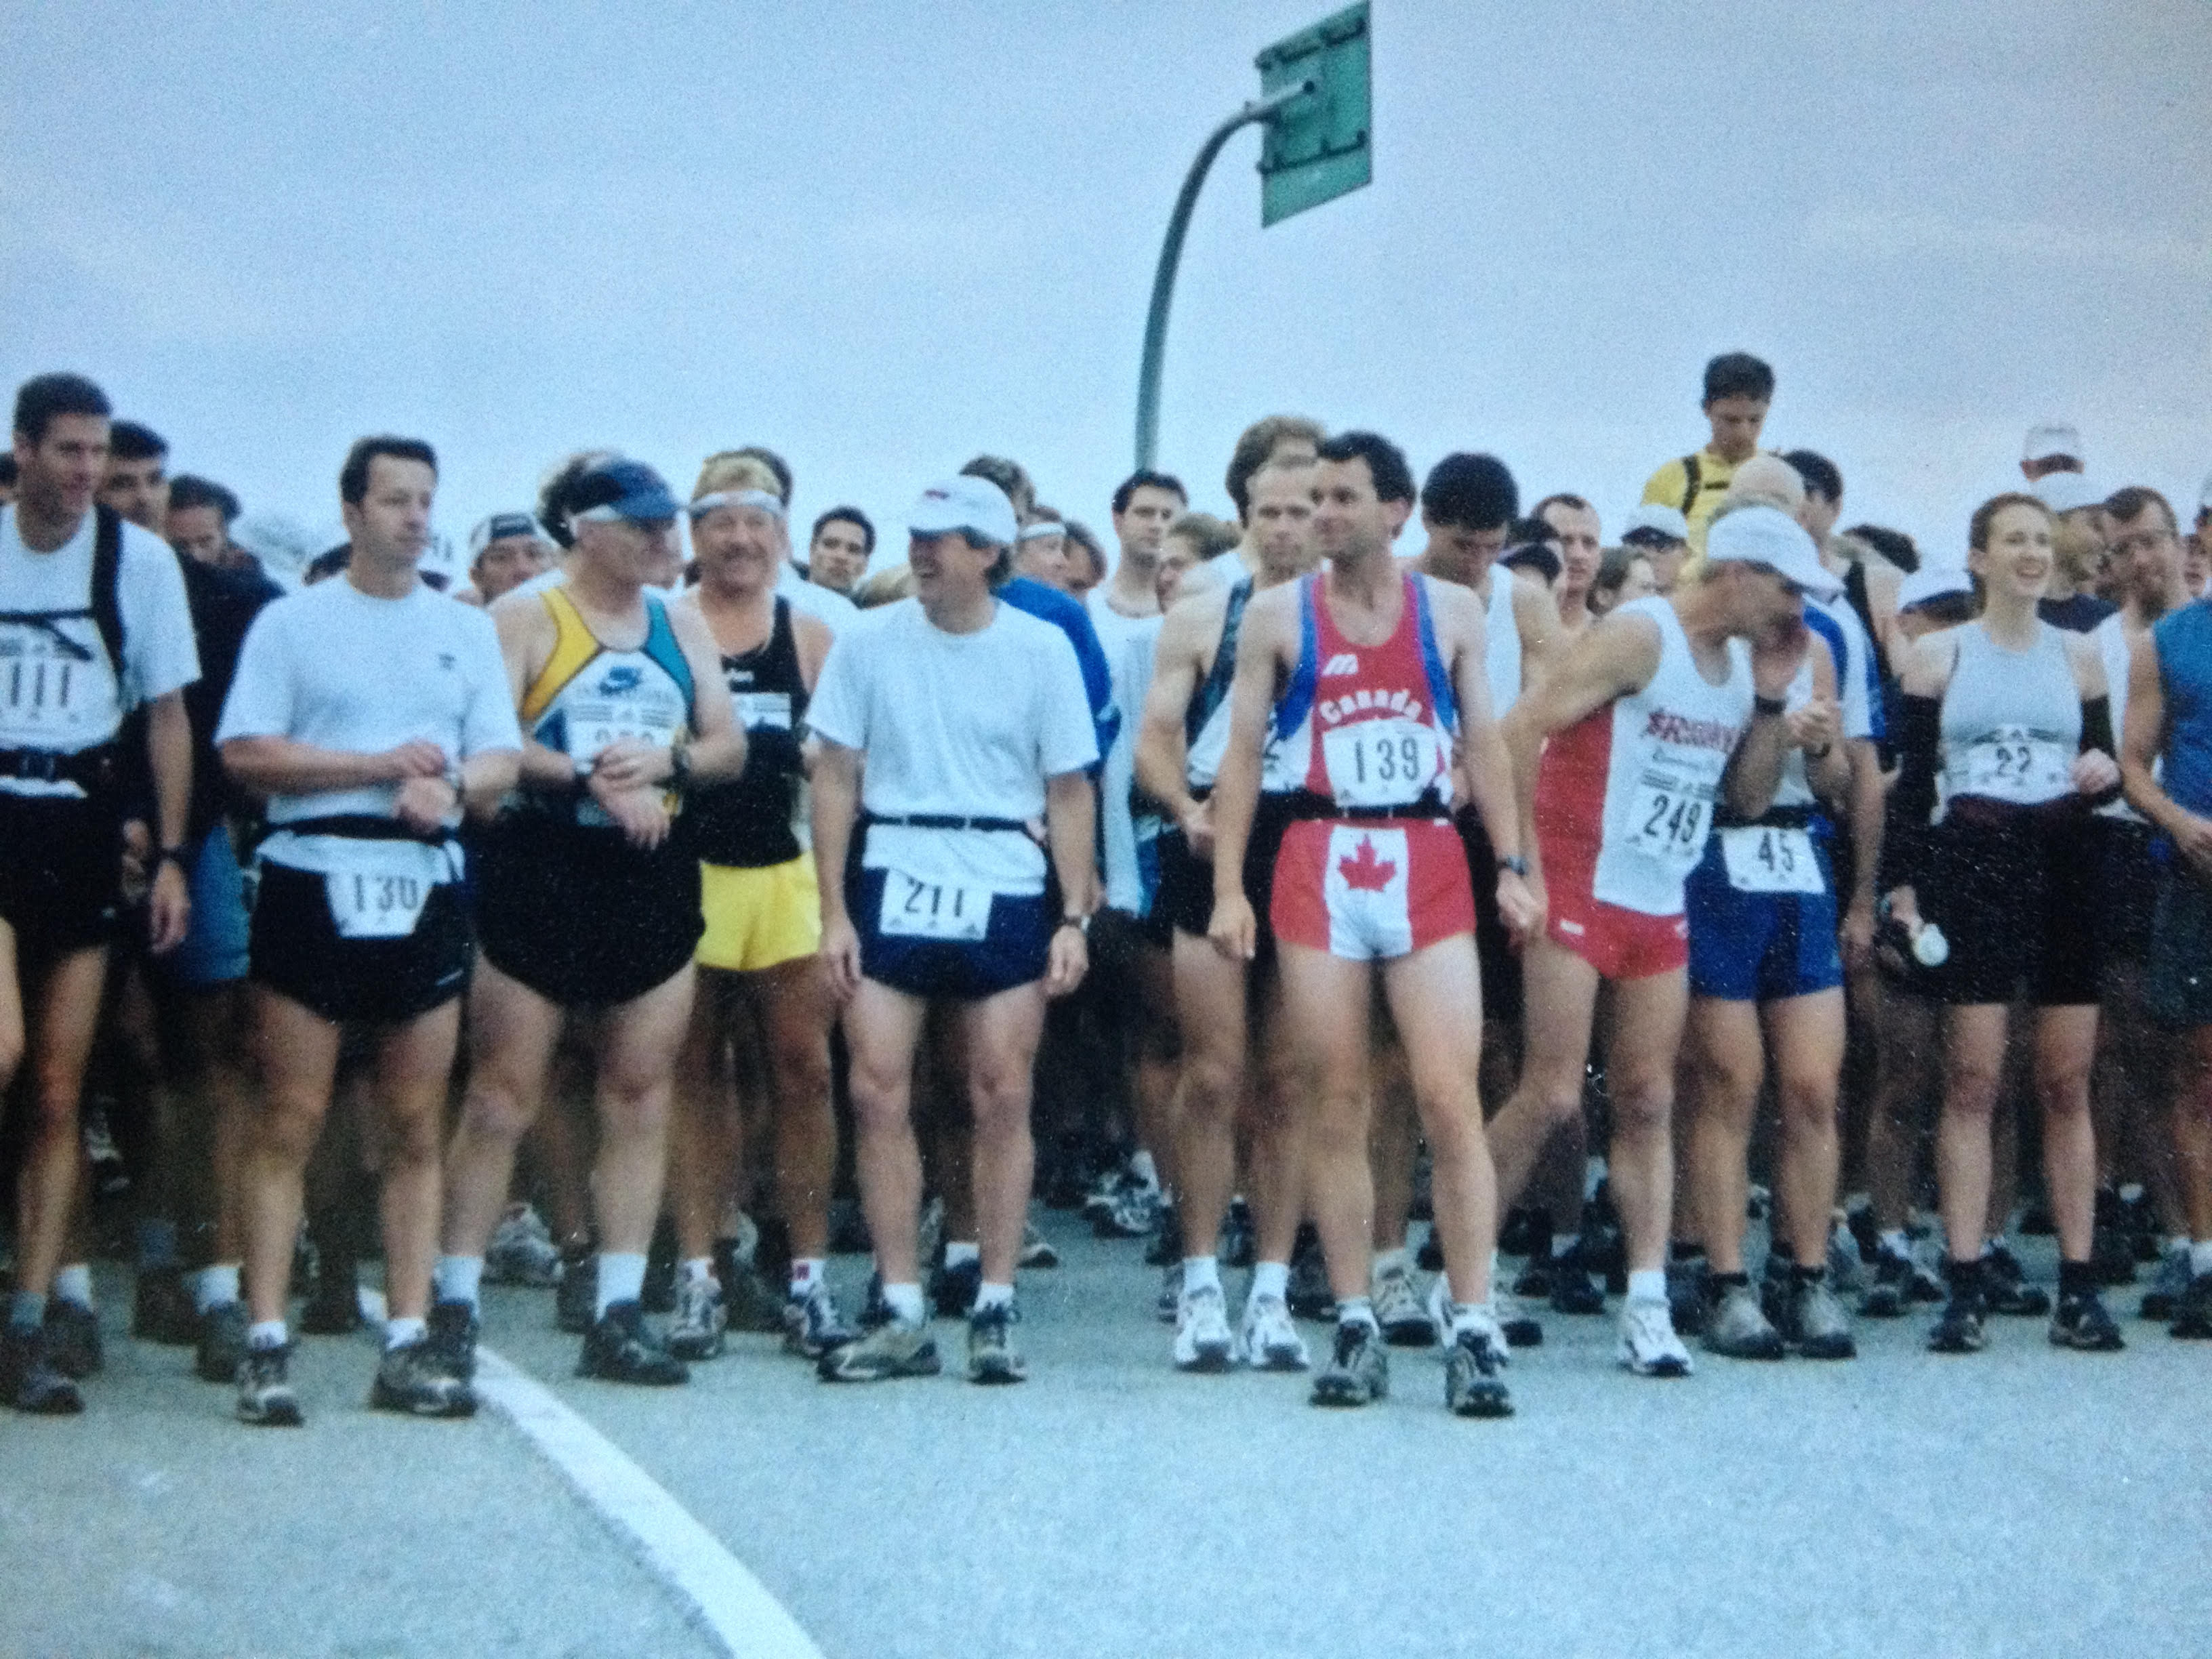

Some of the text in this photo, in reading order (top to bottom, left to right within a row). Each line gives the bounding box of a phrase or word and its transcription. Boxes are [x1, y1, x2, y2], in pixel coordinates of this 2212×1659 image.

[10, 661, 70, 708] 111
[1319, 688, 1422, 724] Canada
[1355, 737, 1420, 783] 139
[1995, 745, 2032, 778] 22
[1643, 794, 1702, 842] 249
[1758, 831, 1795, 872] 45
[354, 874, 418, 913] 130
[904, 875, 965, 918] 211
